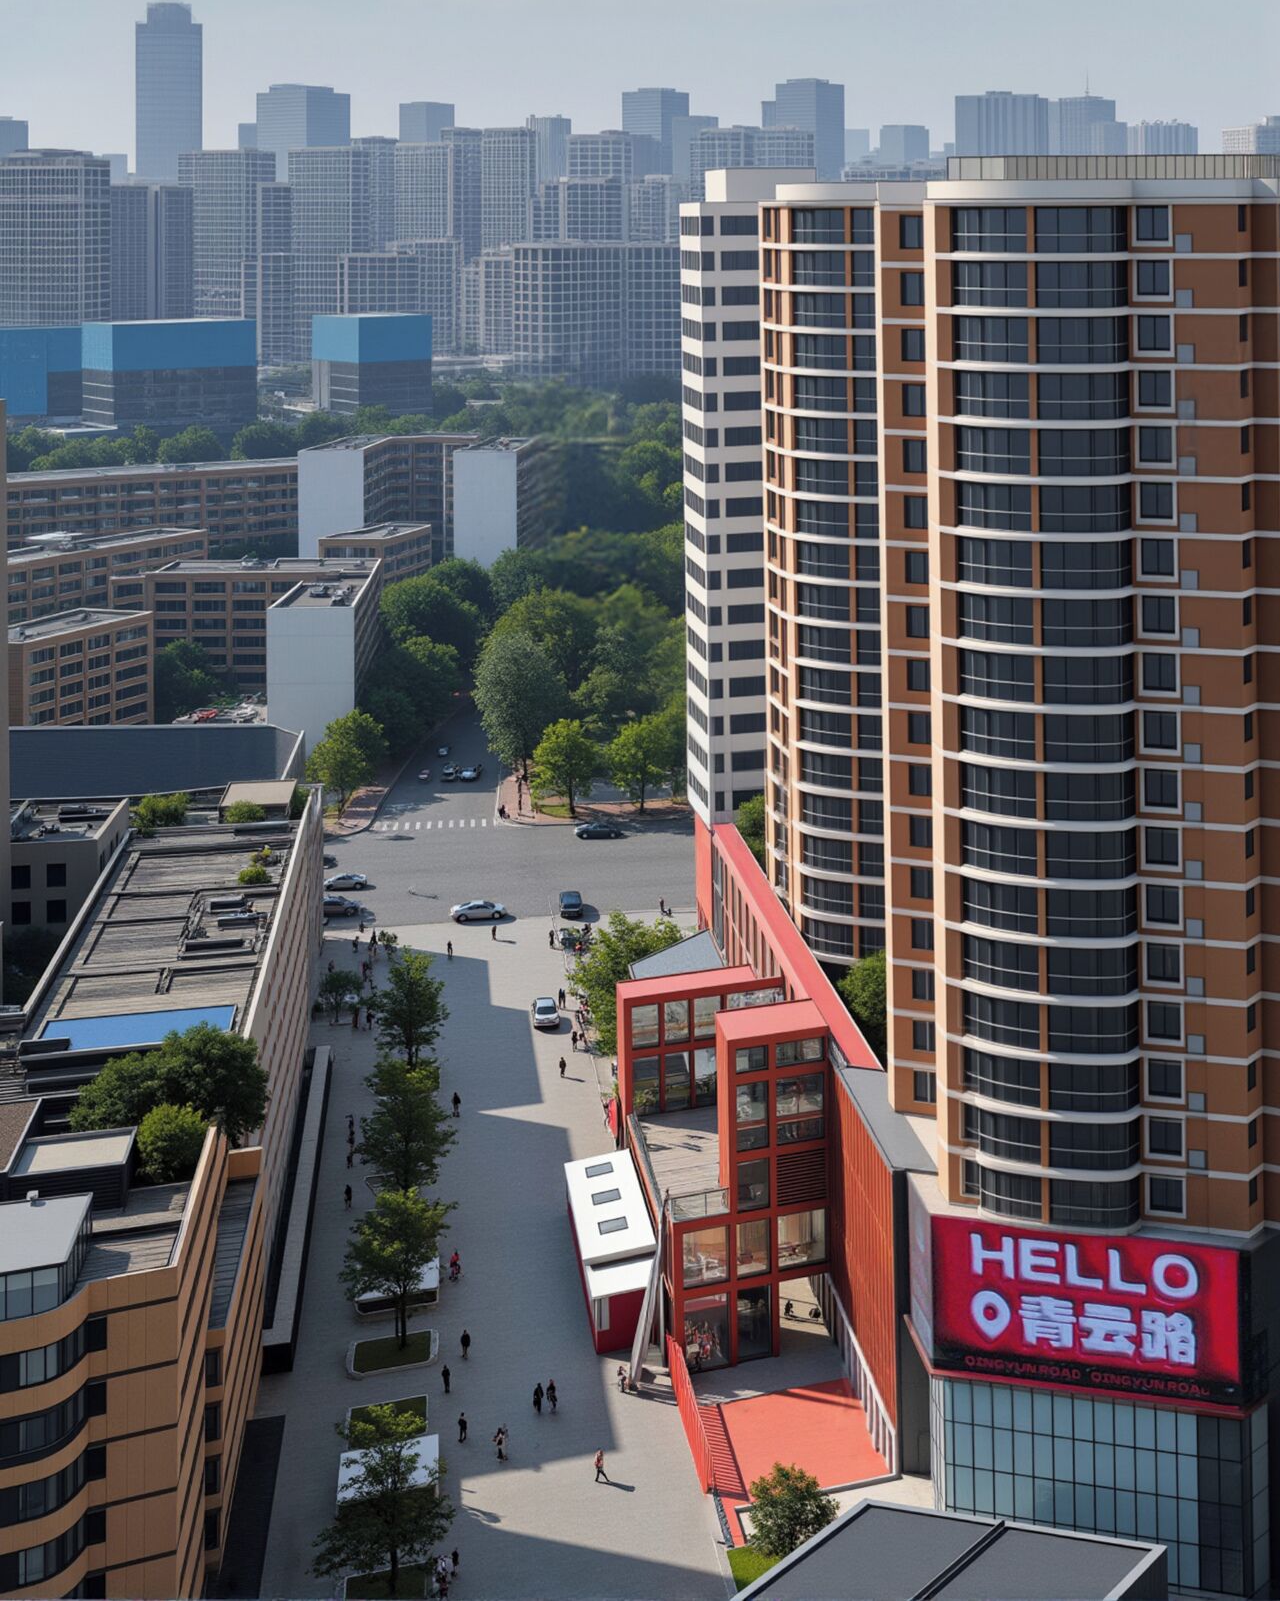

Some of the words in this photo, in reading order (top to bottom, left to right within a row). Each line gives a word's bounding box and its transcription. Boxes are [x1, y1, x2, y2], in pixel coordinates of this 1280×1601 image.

[970, 1233, 1199, 1298] HELLO
[1018, 1295, 1196, 1365] 青云路
